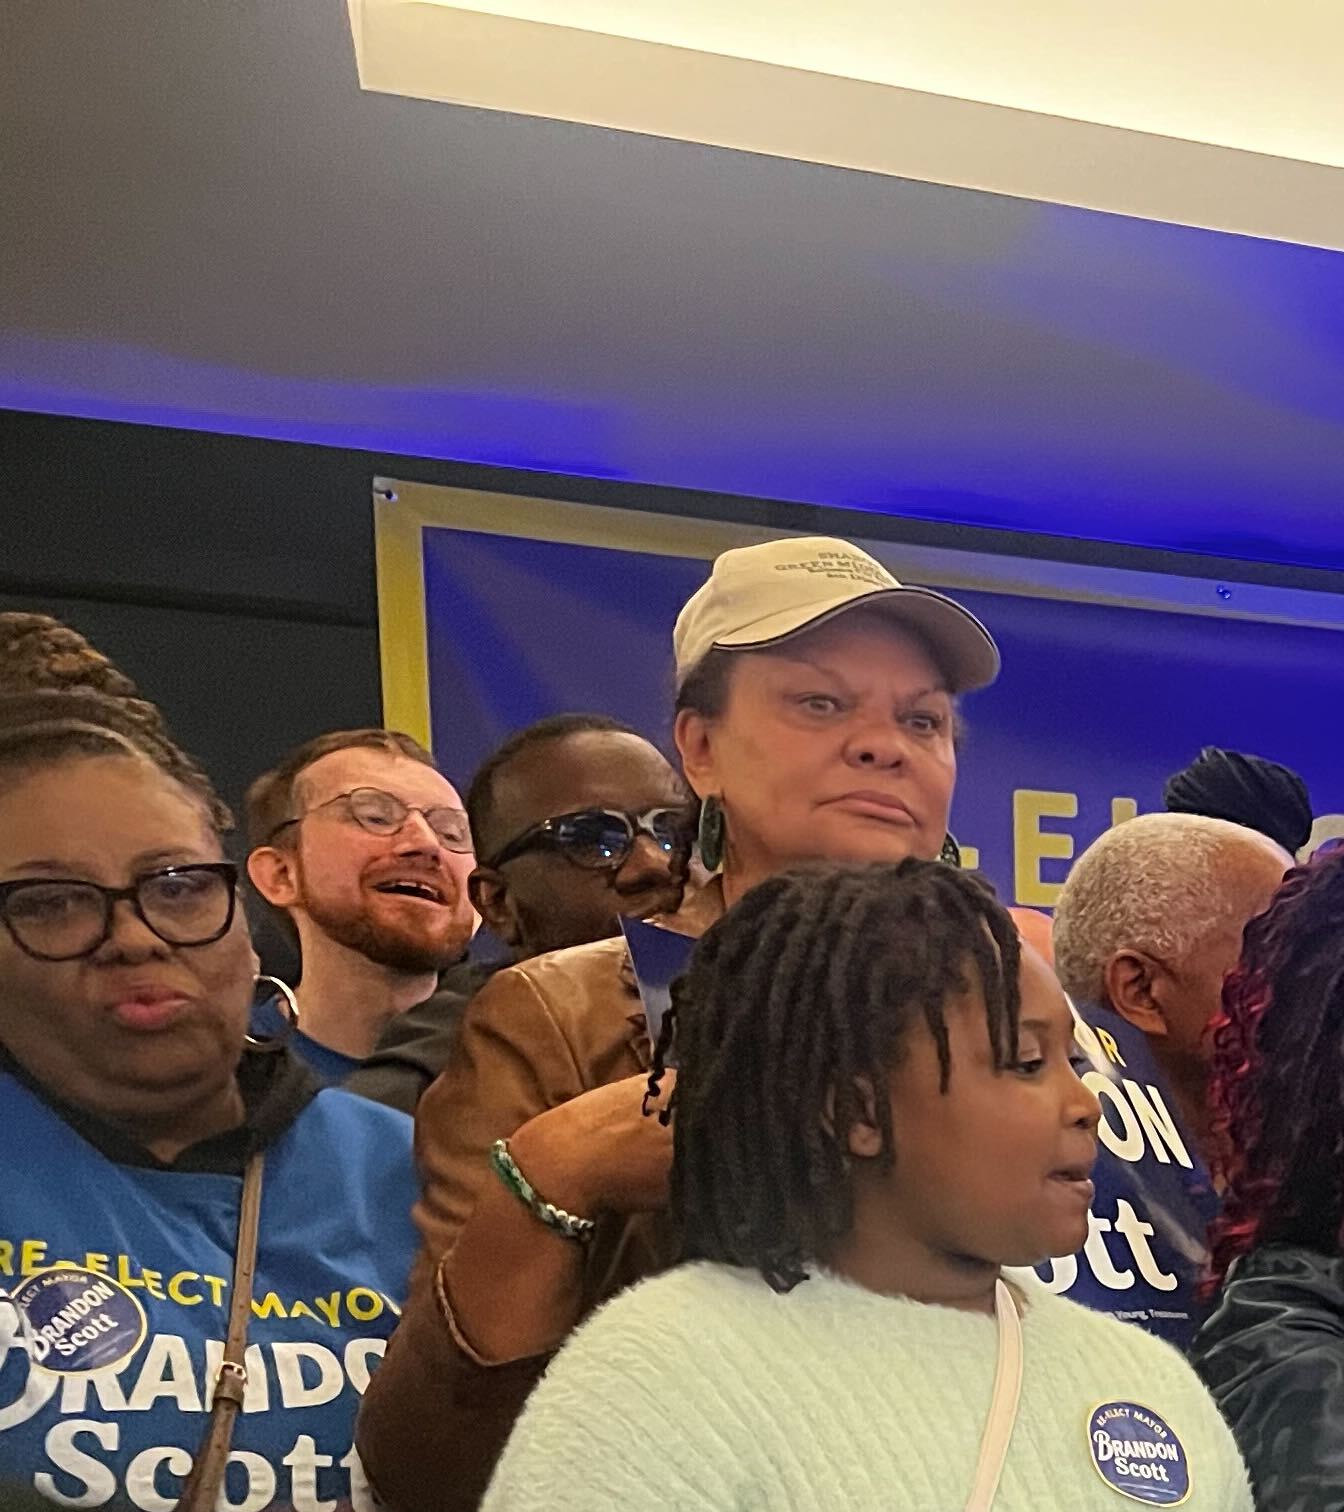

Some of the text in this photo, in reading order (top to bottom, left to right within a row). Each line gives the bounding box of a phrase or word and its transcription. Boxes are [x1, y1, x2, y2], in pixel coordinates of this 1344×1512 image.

[251, 1287, 401, 1329] MAYO
[54, 1313, 119, 1357] Scott
[1093, 1430, 1179, 1461] BRANDON
[1115, 1457, 1170, 1482] Scott
